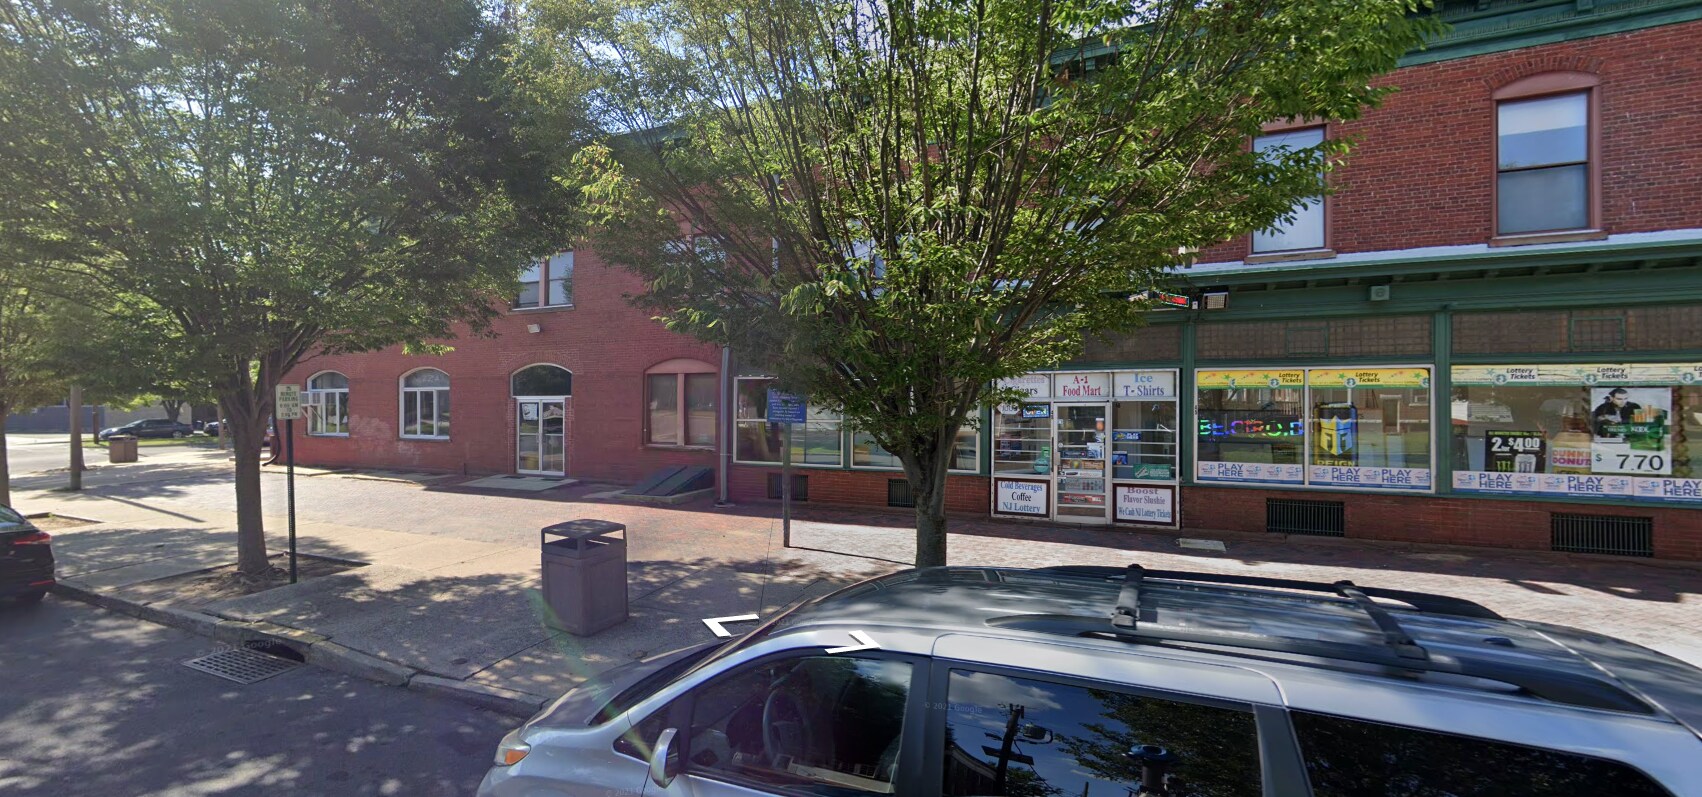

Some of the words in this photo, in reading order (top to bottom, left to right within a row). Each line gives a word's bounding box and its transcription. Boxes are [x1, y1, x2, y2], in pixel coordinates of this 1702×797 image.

[1073, 375, 1088, 384] A-1
[1134, 373, 1153, 383] Ice
[1063, 386, 1080, 397] Food
[1082, 385, 1101, 396] Mart
[1137, 385, 1165, 396] Shirts
[1491, 437, 1503, 452] 2
[1616, 454, 1664, 471] 7.70
[1331, 467, 1360, 475] PLAY
[1381, 469, 1412, 477] PLAY
[1382, 476, 1412, 484] HERE
[1479, 473, 1513, 481] PLAY
[1568, 476, 1604, 484] PLAY
[1000, 481, 1014, 489] Cold
[1015, 482, 1043, 493] Beverages
[1479, 481, 1513, 489] HERE
[1568, 484, 1603, 492] HERE
[1663, 480, 1702, 489] PLAY
[1011, 491, 1032, 502] Coffee
[1664, 488, 1702, 496] HERE
[1123, 494, 1142, 504] Flavor
[1144, 495, 1166, 504] Slushie
[1002, 501, 1013, 512] NJ
[1014, 502, 1041, 514] Lottery
[1142, 508, 1156, 519] Lottery
